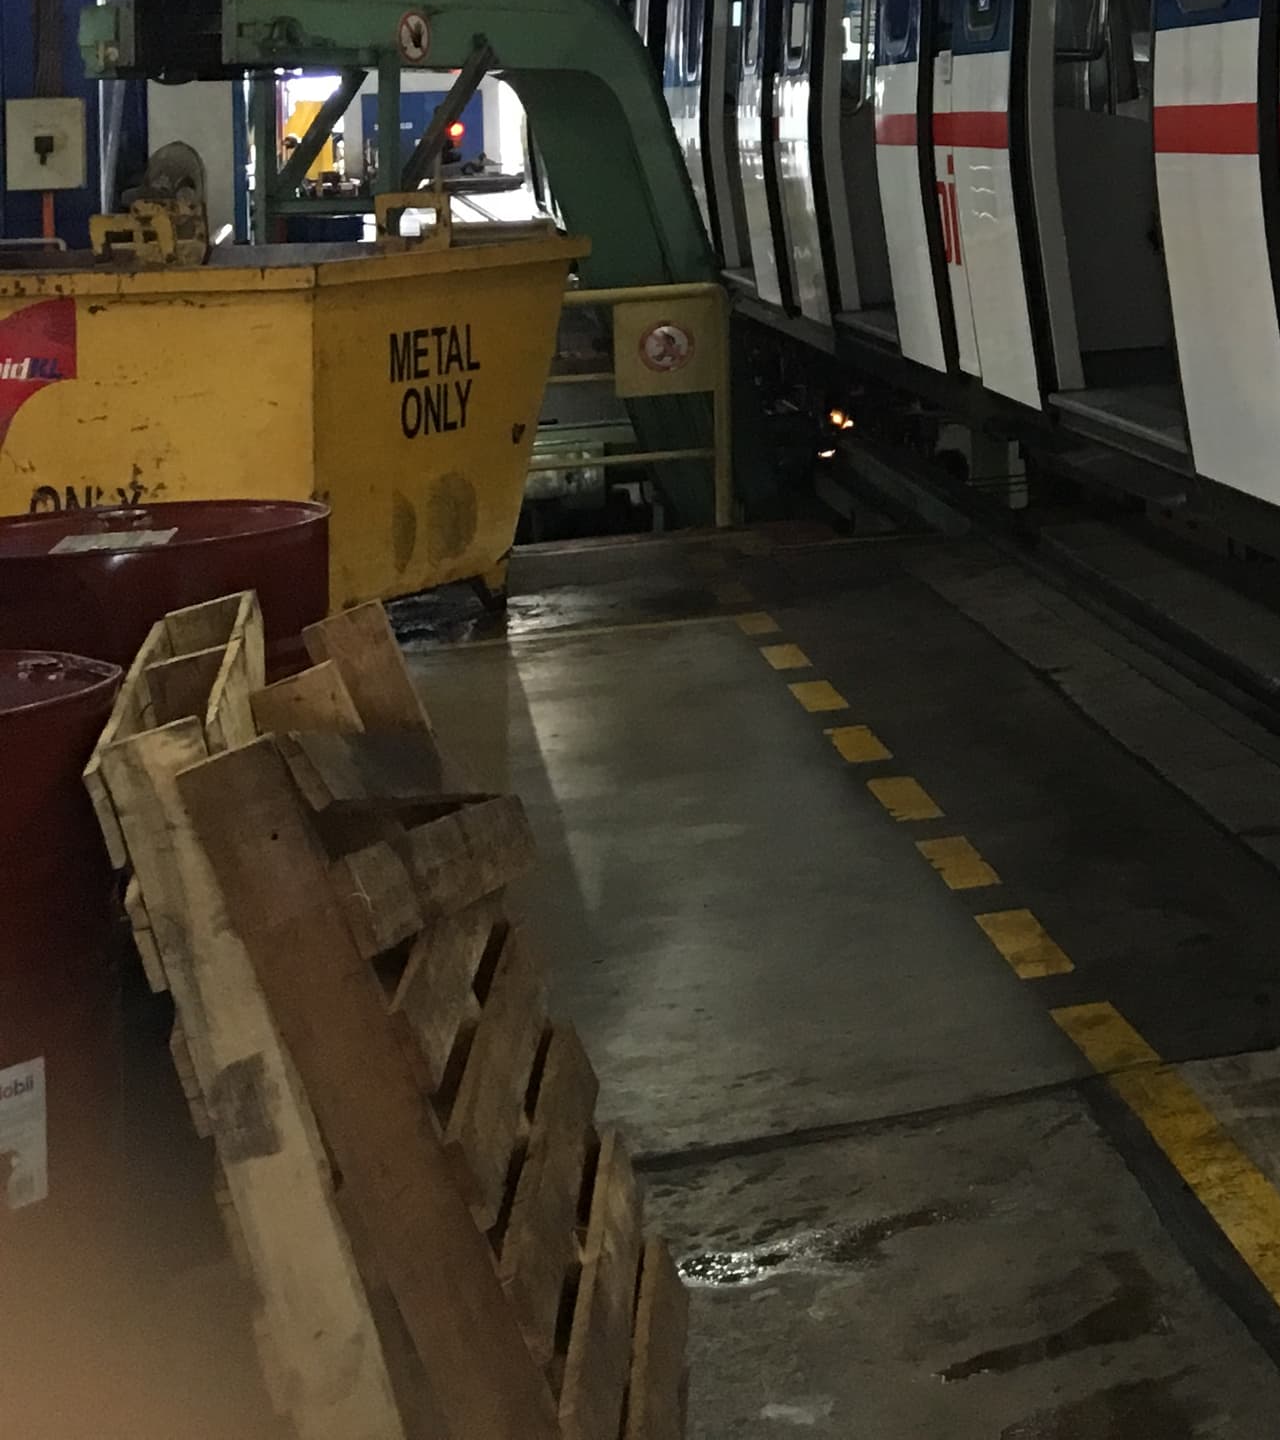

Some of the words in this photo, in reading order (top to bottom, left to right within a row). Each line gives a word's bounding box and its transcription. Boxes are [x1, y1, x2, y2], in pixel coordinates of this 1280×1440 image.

[389, 323, 481, 384] METAL
[401, 378, 473, 440] ONLY
[0, 1072, 34, 1101] obil
